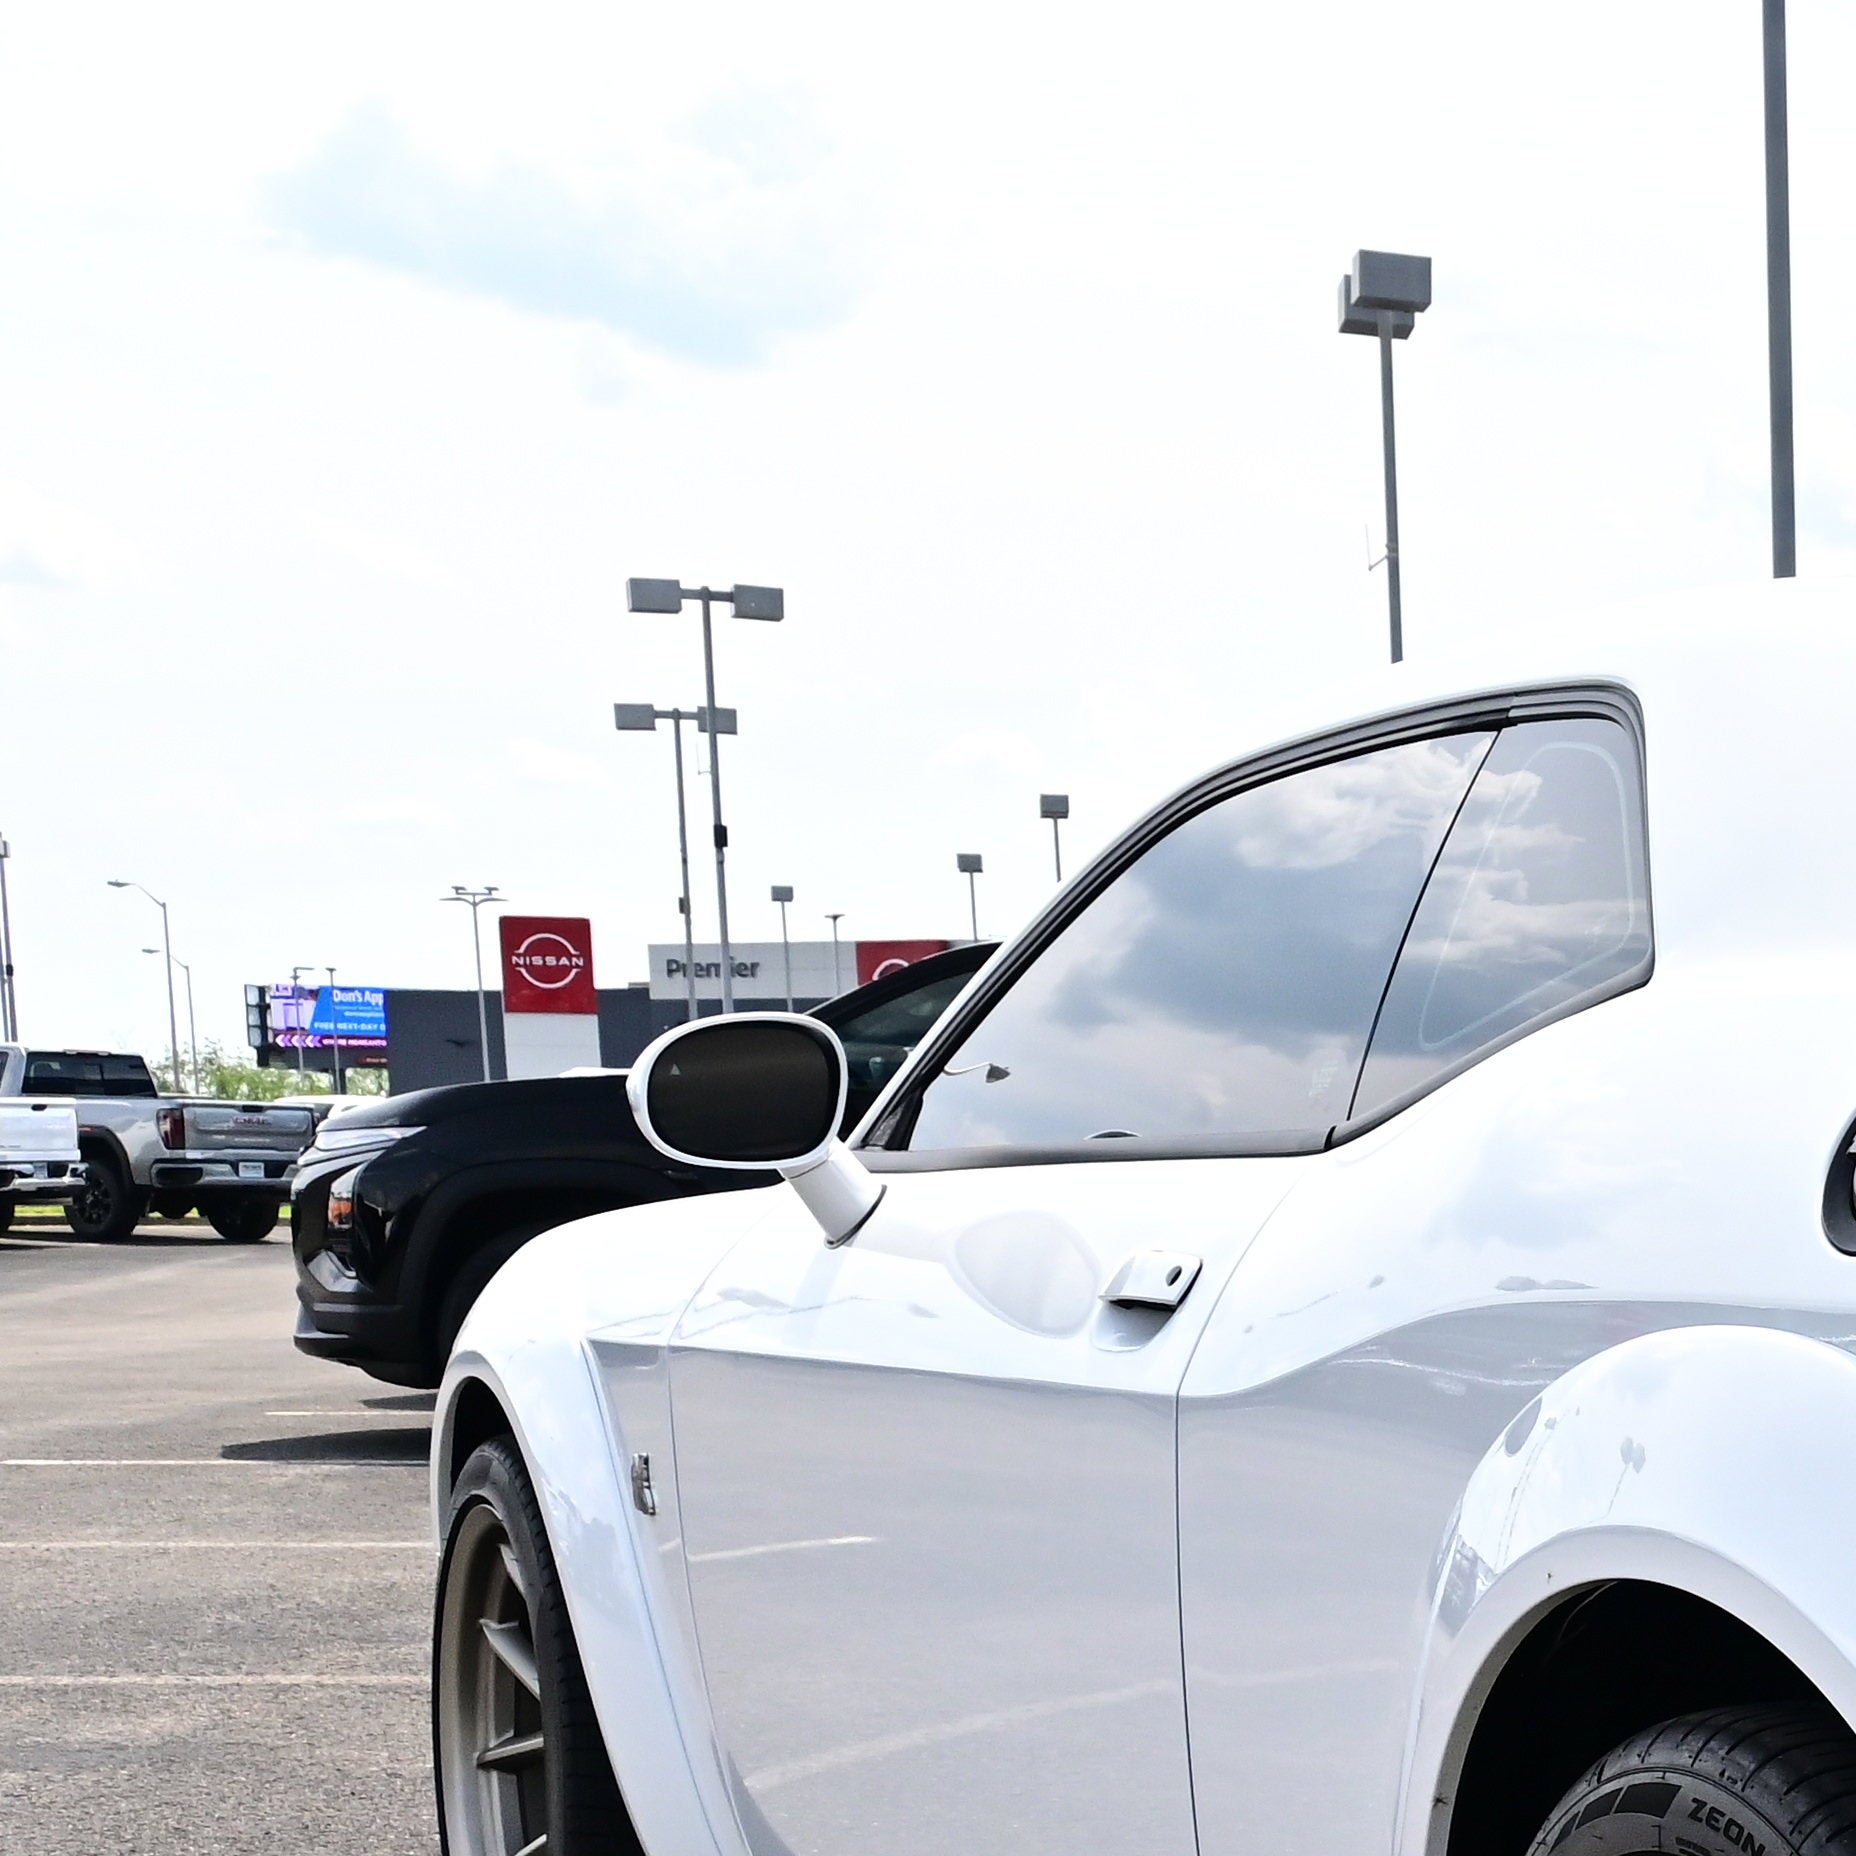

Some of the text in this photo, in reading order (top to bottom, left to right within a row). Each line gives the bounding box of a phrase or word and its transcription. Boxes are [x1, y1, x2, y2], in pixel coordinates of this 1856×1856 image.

[511, 954, 584, 968] NISSAN
[666, 956, 760, 979] Premier
[333, 989, 363, 1002] Don's
